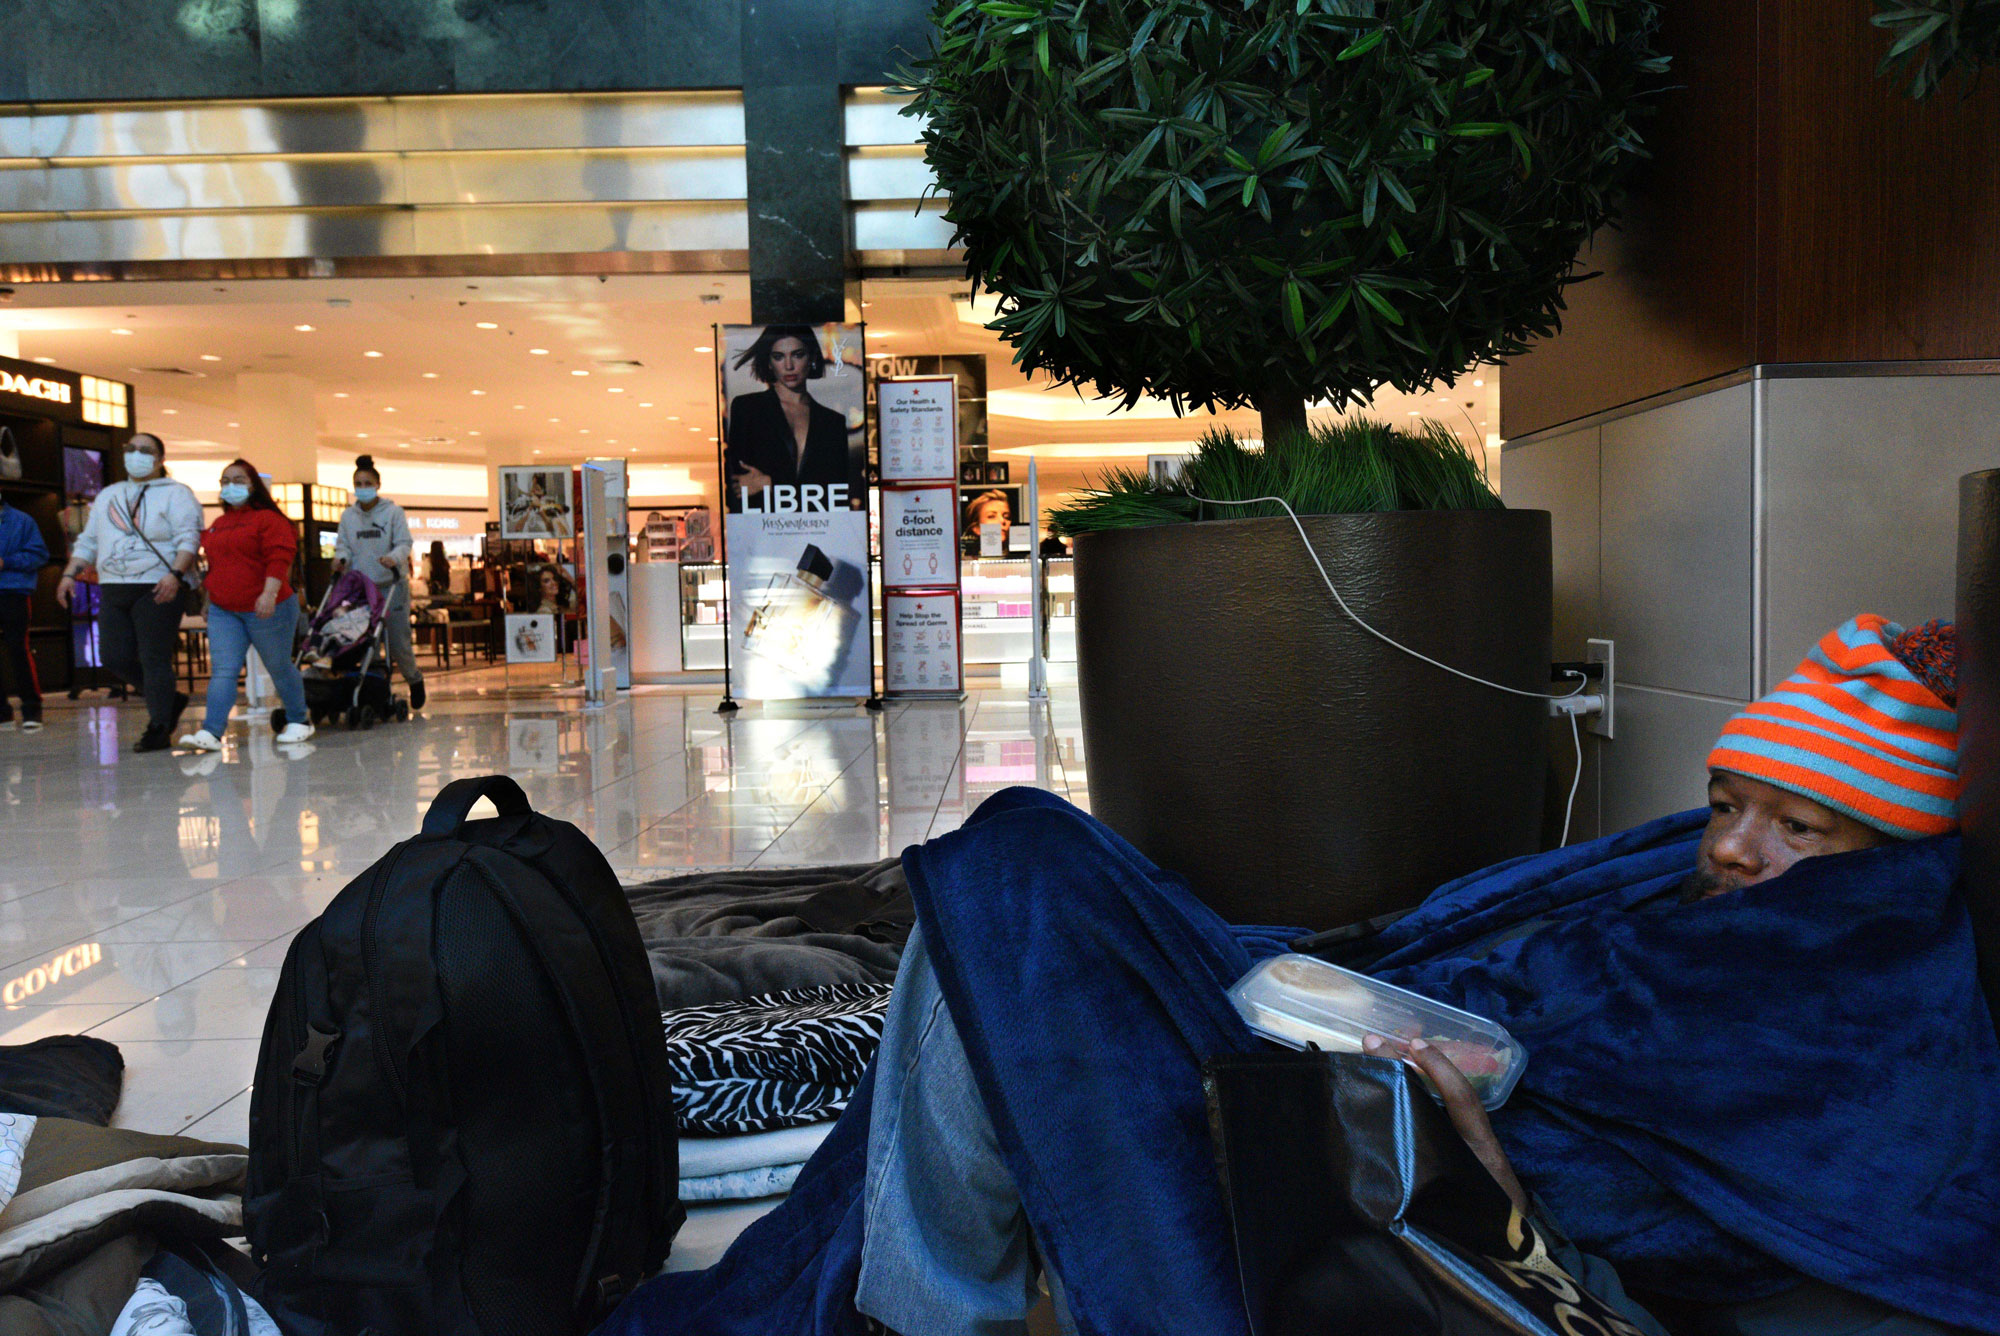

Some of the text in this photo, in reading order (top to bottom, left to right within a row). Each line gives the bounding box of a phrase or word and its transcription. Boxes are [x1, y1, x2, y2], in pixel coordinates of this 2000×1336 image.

[0, 369, 71, 404] OACH
[741, 483, 851, 514] LIBRE
[902, 514, 936, 525] 6-foot
[895, 527, 943, 537] distance
